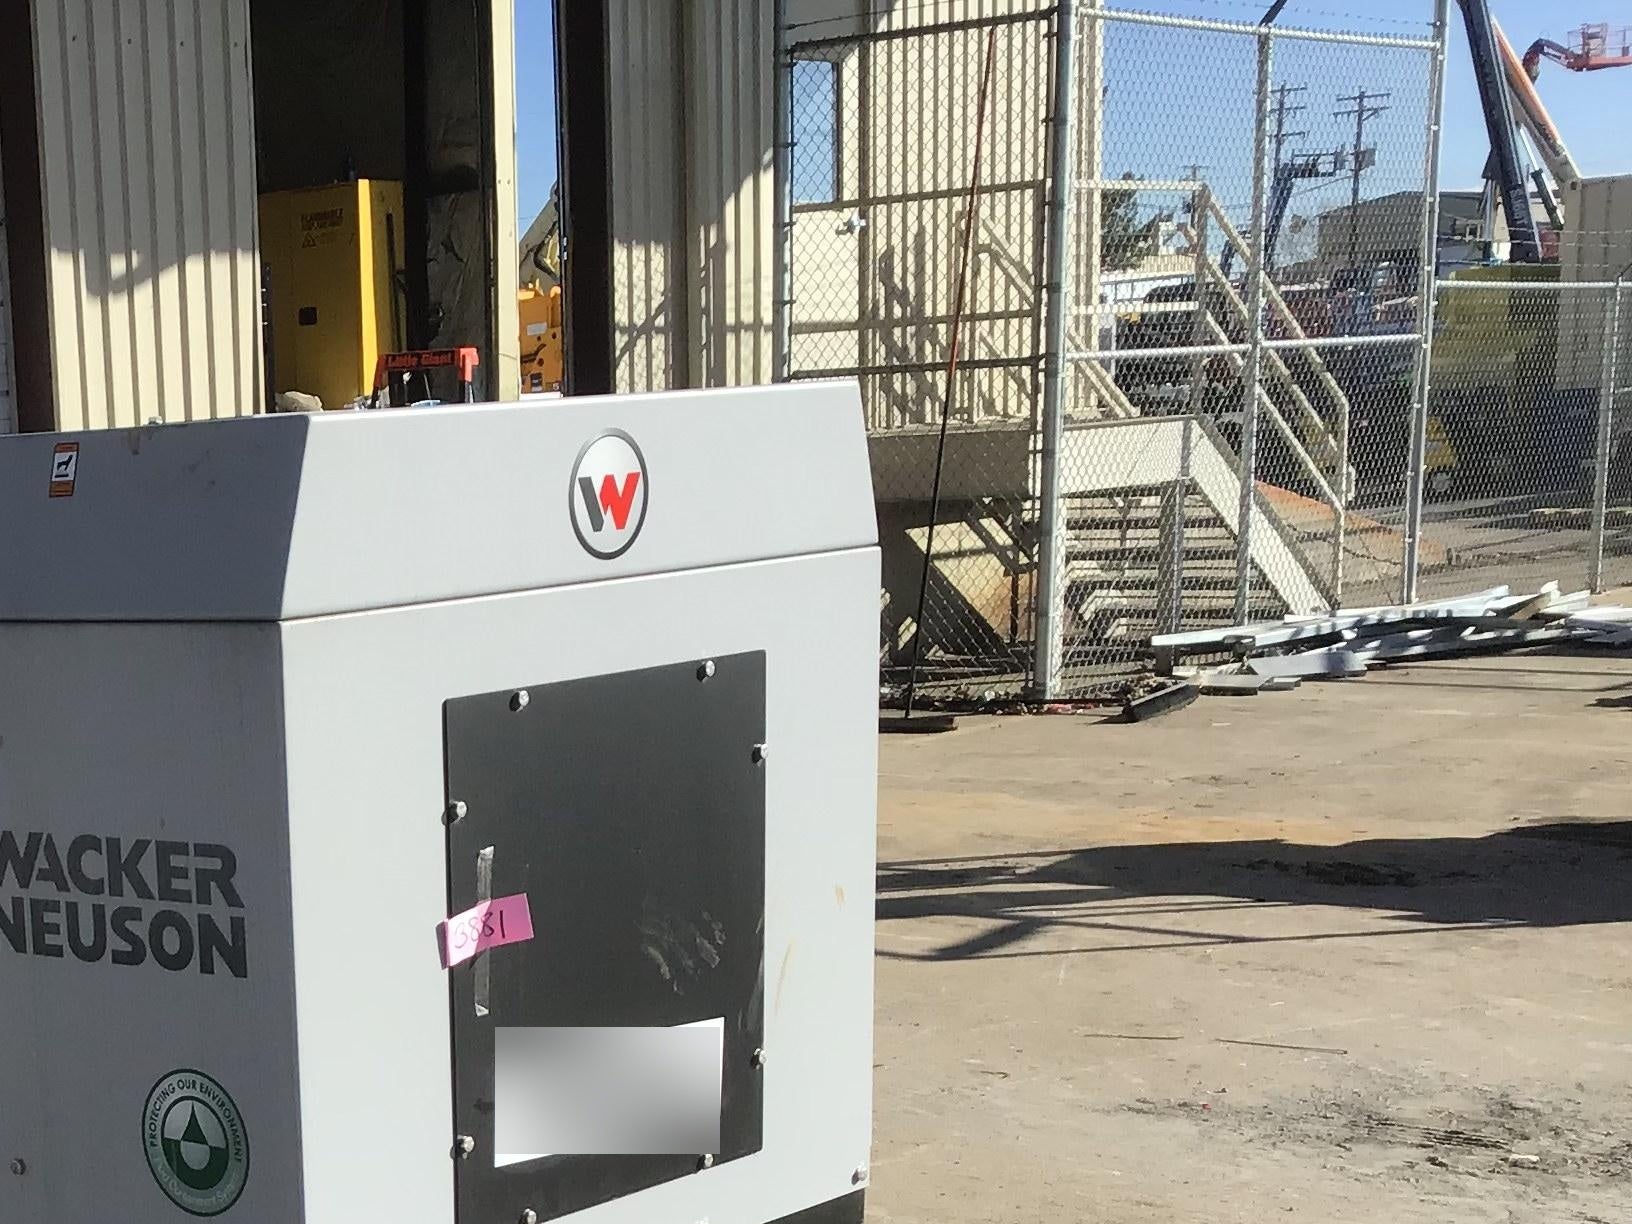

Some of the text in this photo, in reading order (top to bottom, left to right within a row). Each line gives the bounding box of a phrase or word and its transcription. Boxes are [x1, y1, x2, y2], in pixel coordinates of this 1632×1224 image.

[149, 1079, 242, 1163] PROTECTING OUR ENVIRONMENT
